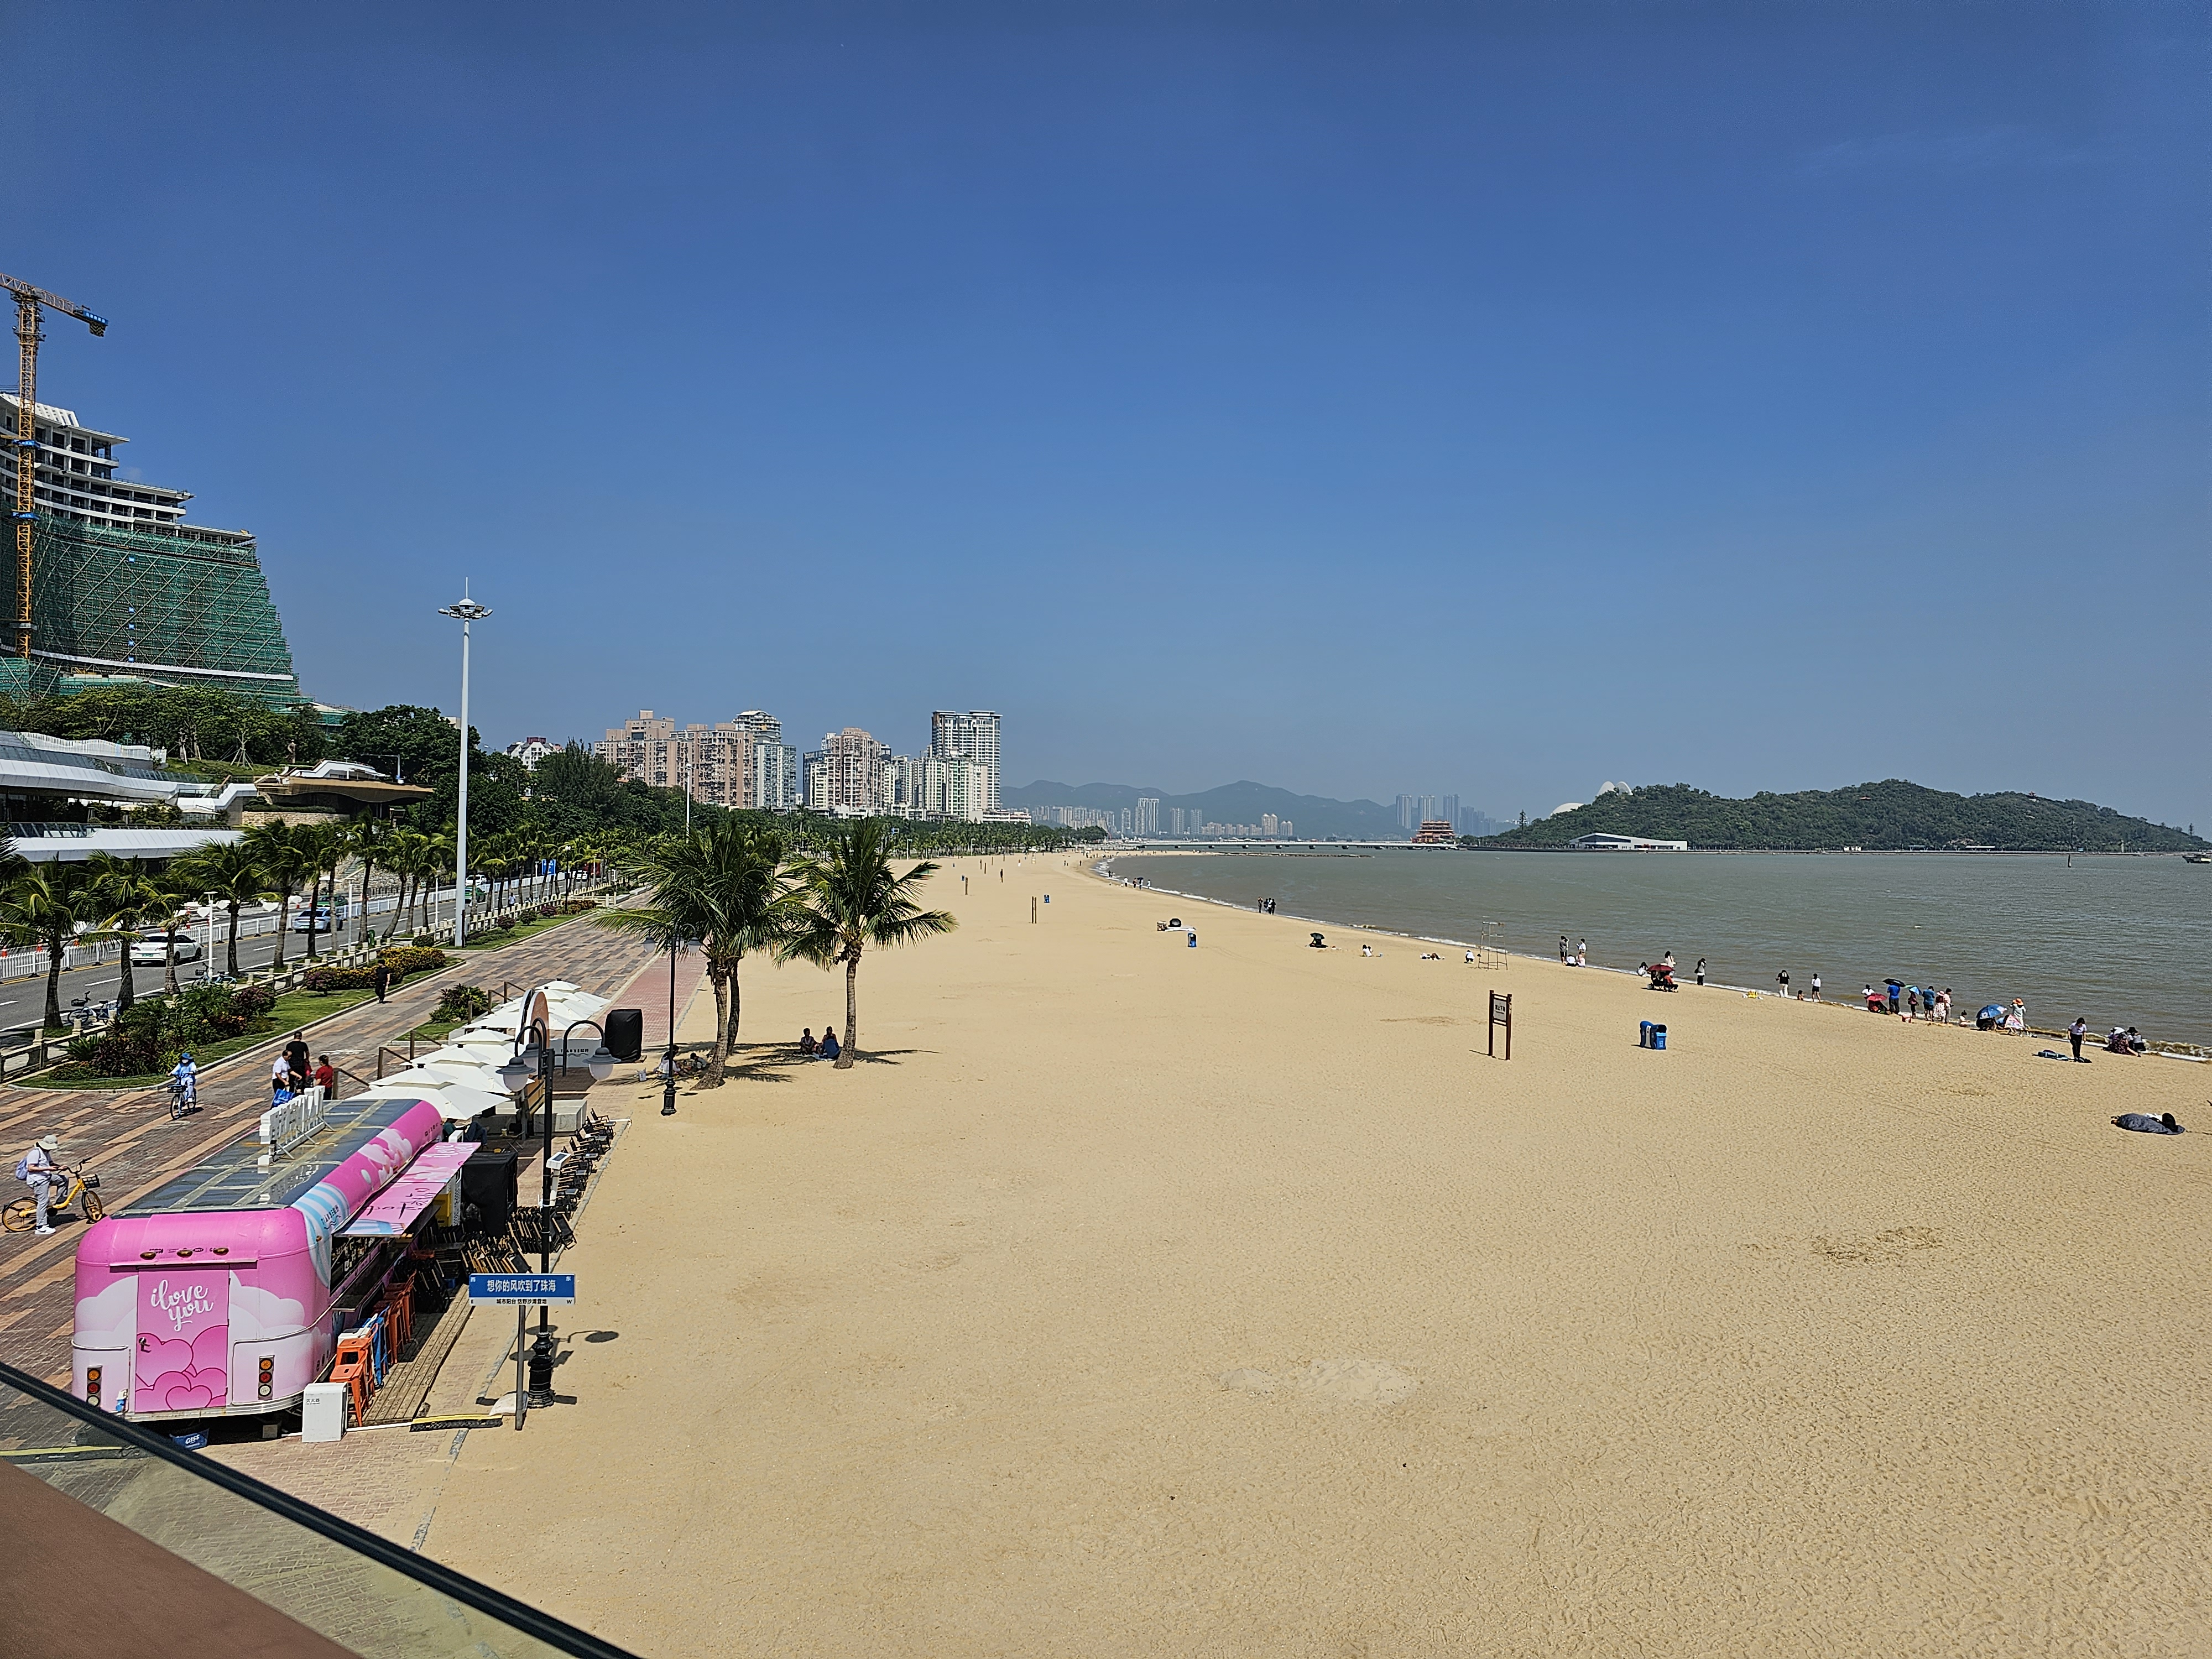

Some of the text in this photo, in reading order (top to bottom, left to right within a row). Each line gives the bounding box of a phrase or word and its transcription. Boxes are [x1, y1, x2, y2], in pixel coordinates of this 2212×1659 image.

[487, 1279, 556, 1292] 想你的风吹到了珠海
[168, 1300, 214, 1332] you
